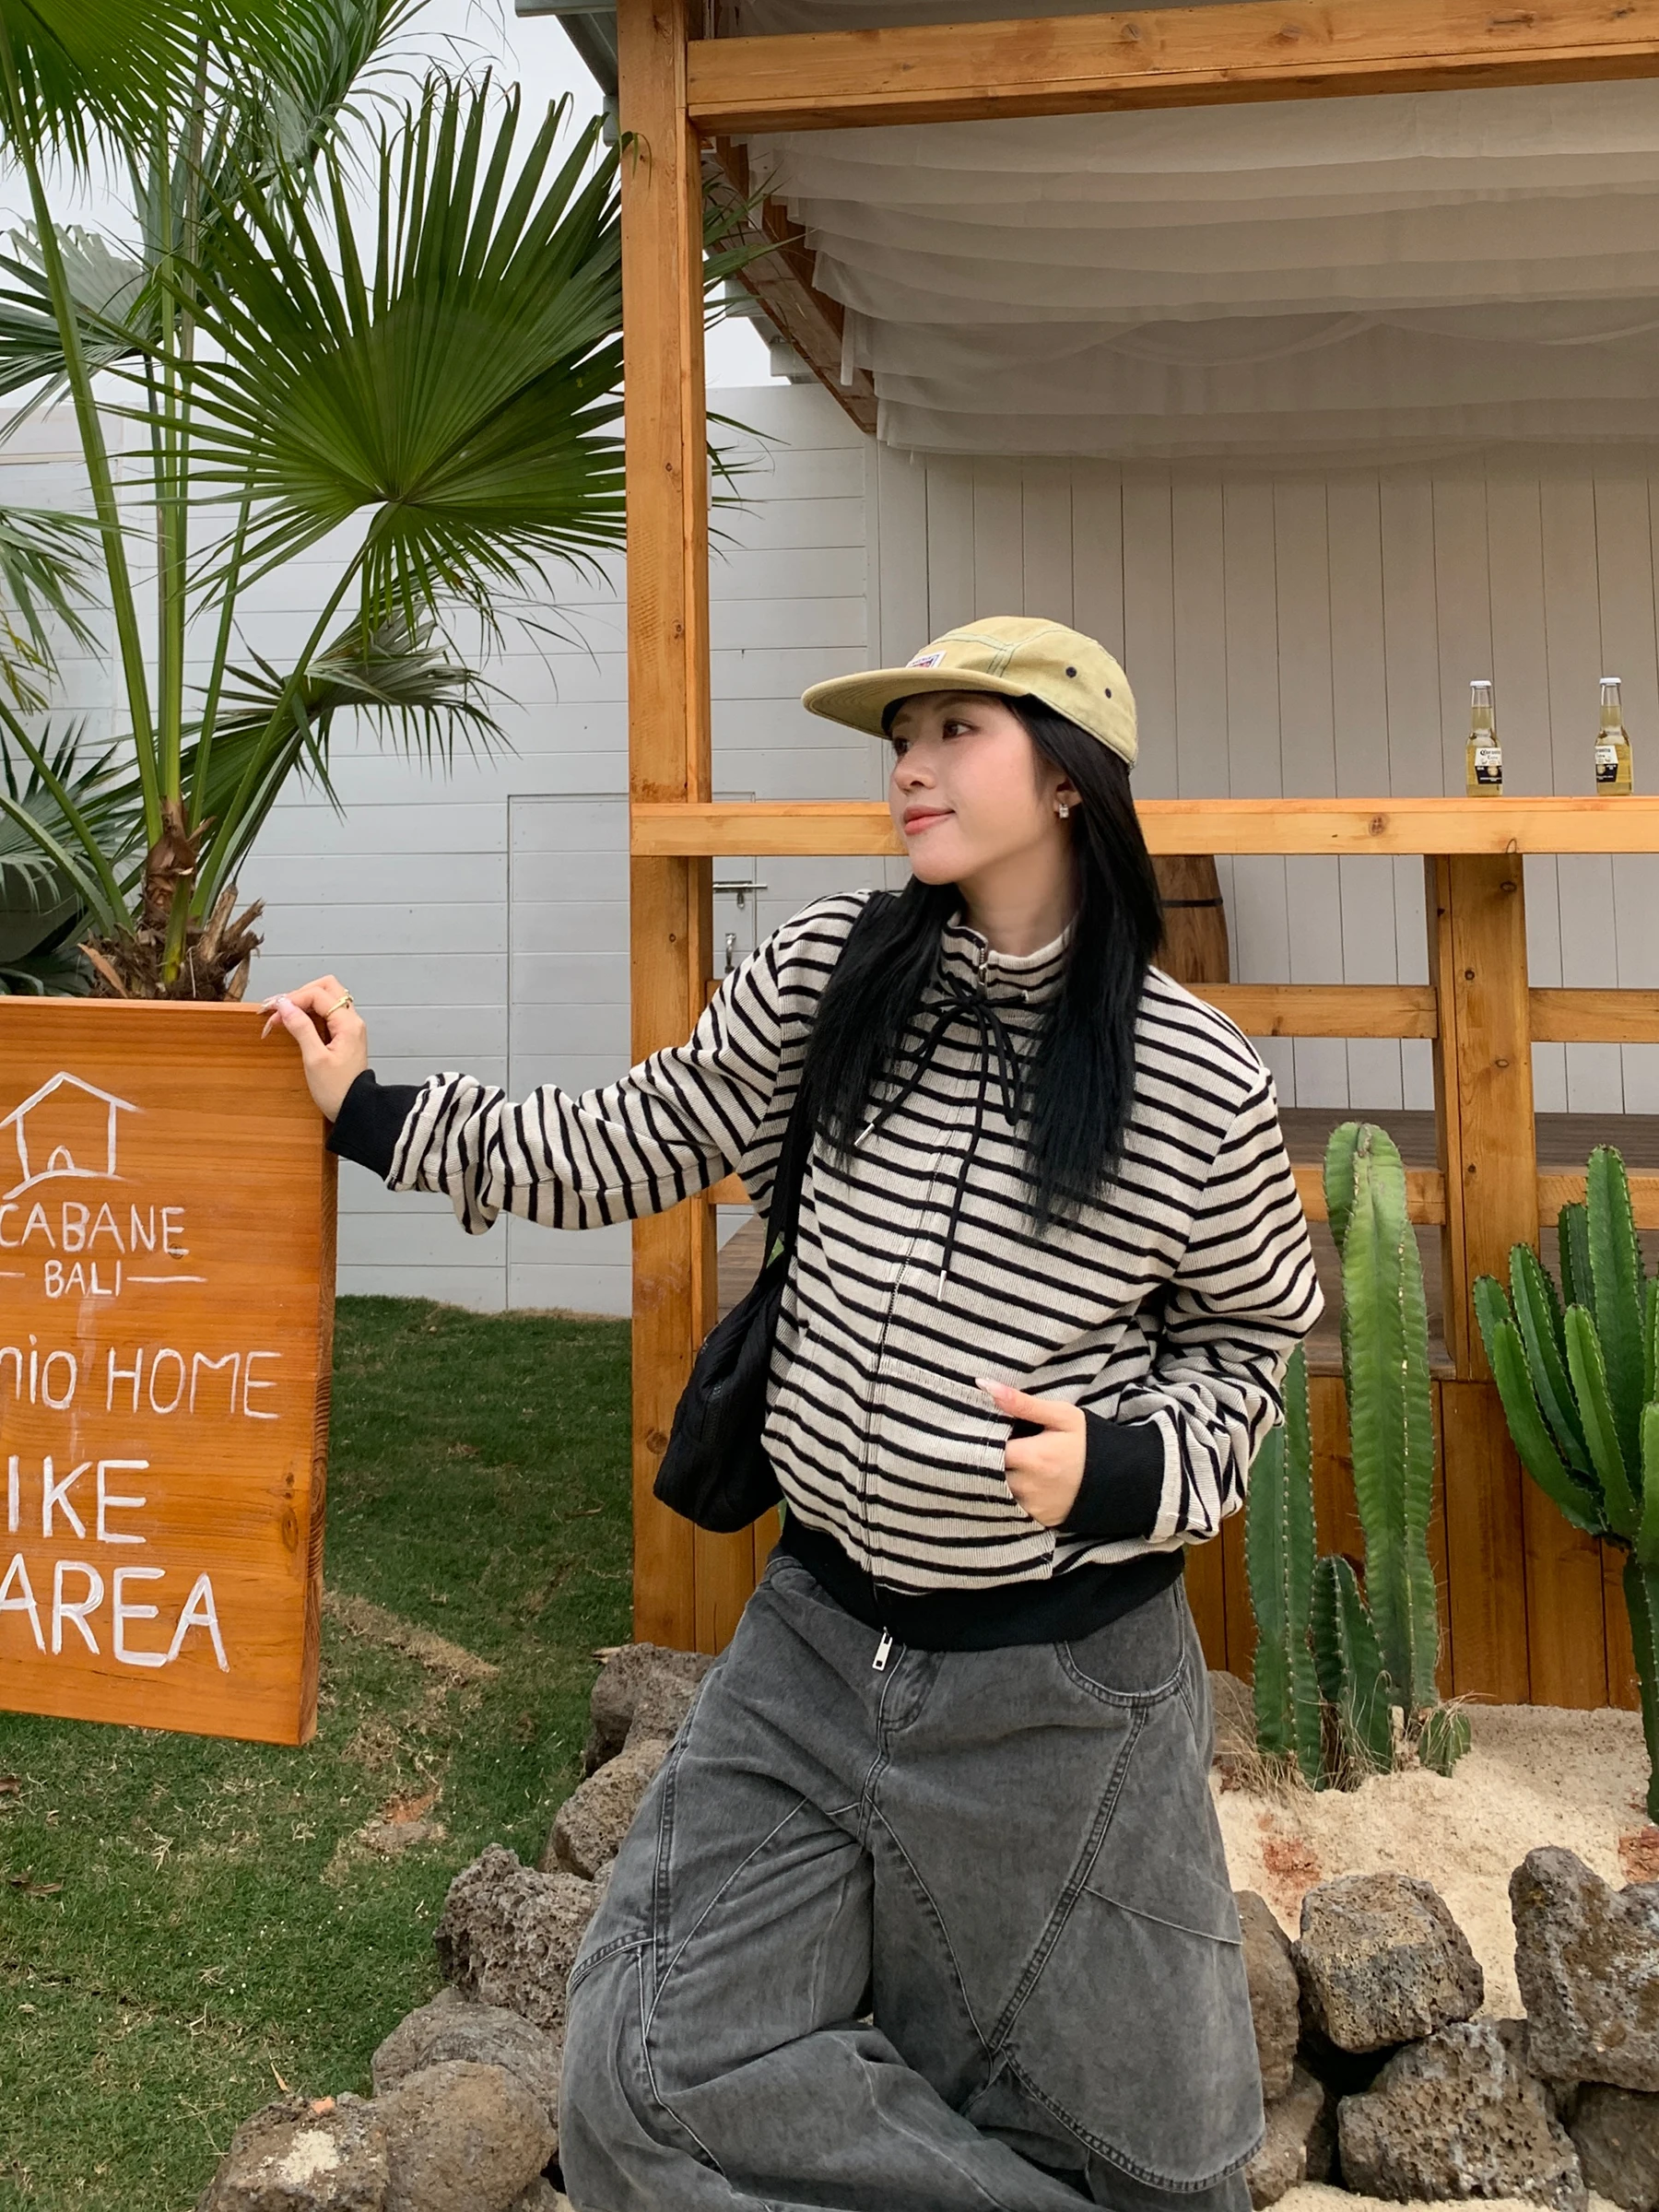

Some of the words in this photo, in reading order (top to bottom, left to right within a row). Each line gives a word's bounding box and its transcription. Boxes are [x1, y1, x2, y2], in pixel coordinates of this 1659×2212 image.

[0, 1201, 190, 1254] CABANE
[44, 1259, 121, 1299] BALI
[106, 1346, 284, 1419] HOME
[7, 1454, 150, 1544] IKE
[0, 1552, 230, 1674] AREA
